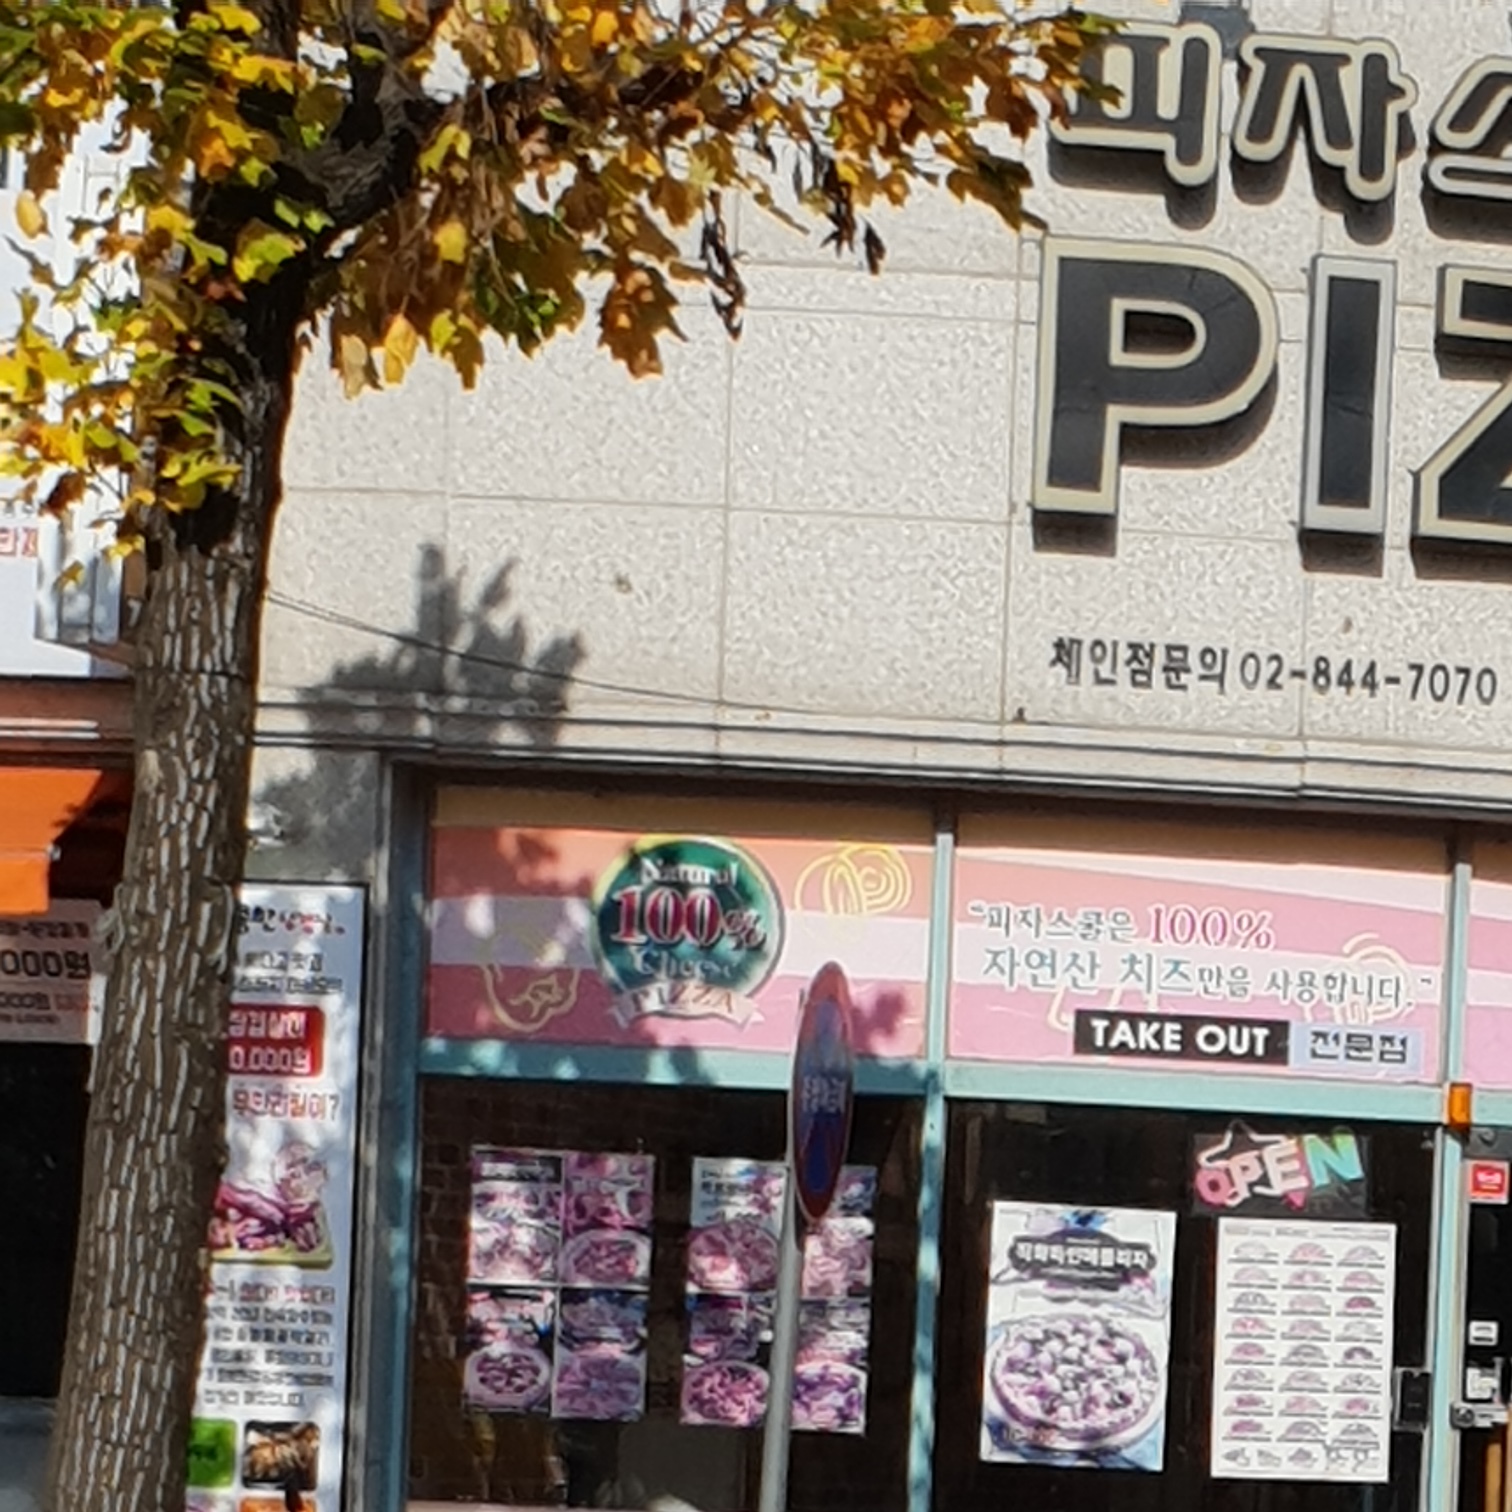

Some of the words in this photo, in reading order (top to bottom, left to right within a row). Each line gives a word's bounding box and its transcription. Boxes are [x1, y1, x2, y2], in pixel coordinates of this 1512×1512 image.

[1240, 645, 1499, 707] 02-844-7070
[609, 885, 768, 950] 100%
[1147, 905, 1276, 951] 100%
[981, 946, 1102, 990] 자연산
[1091, 1019, 1184, 1053] TAKE
[1195, 1023, 1271, 1057] OUT
[1307, 1028, 1410, 1066] 전문점
[1194, 1130, 1365, 1208] OPEN
